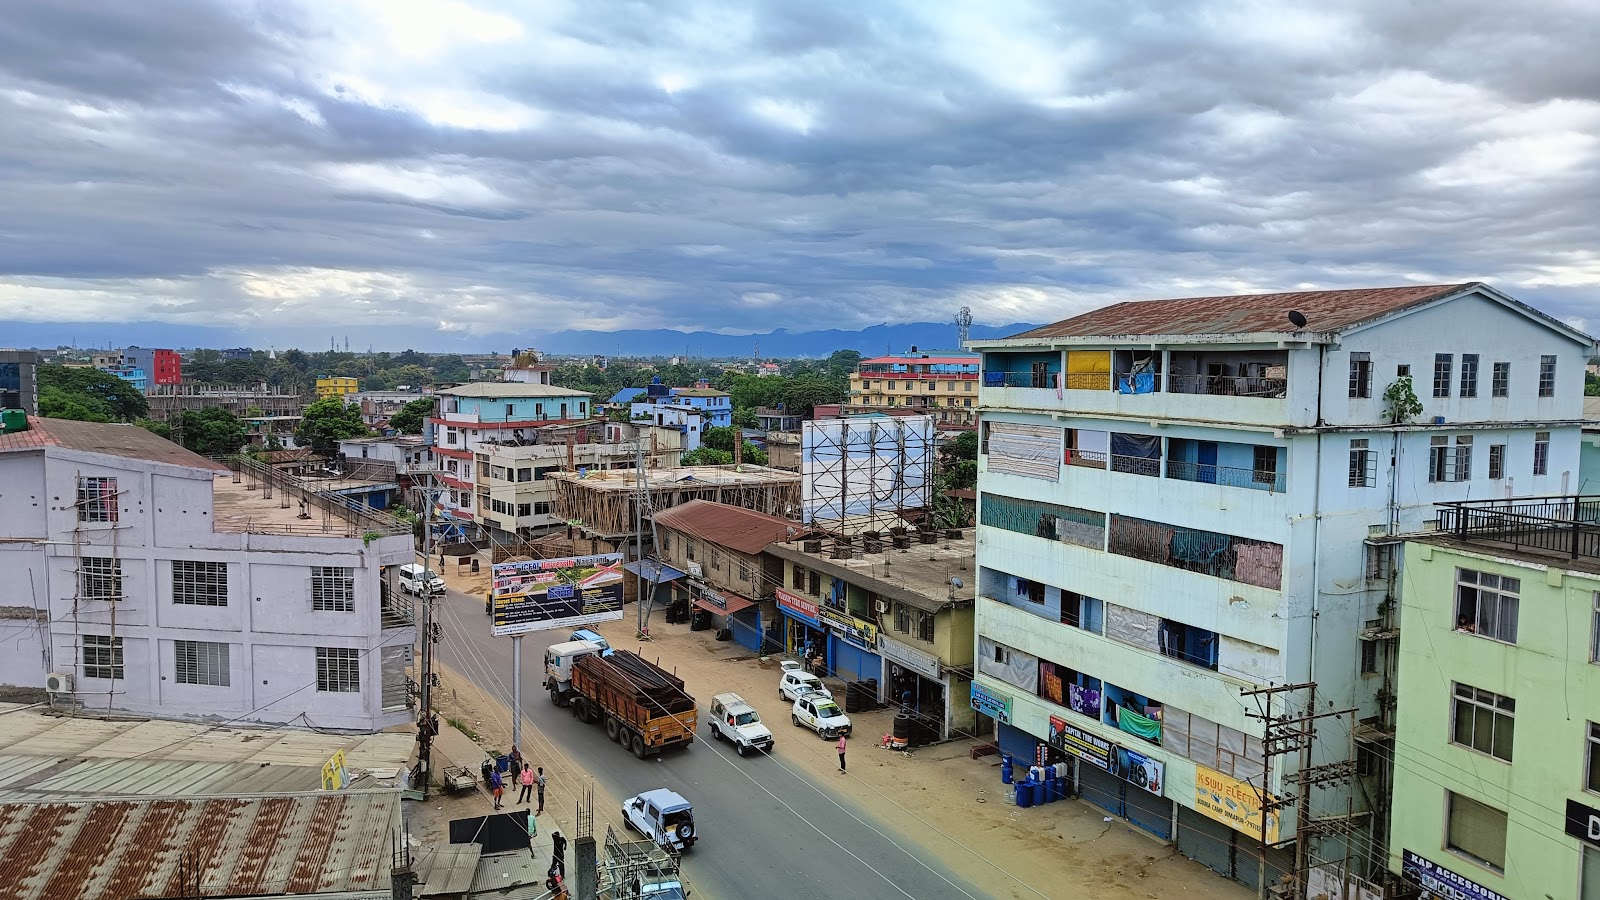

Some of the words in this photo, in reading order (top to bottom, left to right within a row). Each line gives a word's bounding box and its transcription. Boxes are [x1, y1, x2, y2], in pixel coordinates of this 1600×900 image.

[1197, 797, 1211, 809] BURMA
[1211, 804, 1223, 815] CAMP
[1198, 773, 1204, 784] K
[1205, 776, 1223, 792] SWU
[1225, 785, 1263, 806] ELECTRI
[1411, 854, 1432, 869] KAP
[1435, 866, 1507, 900] ACCESSORI
